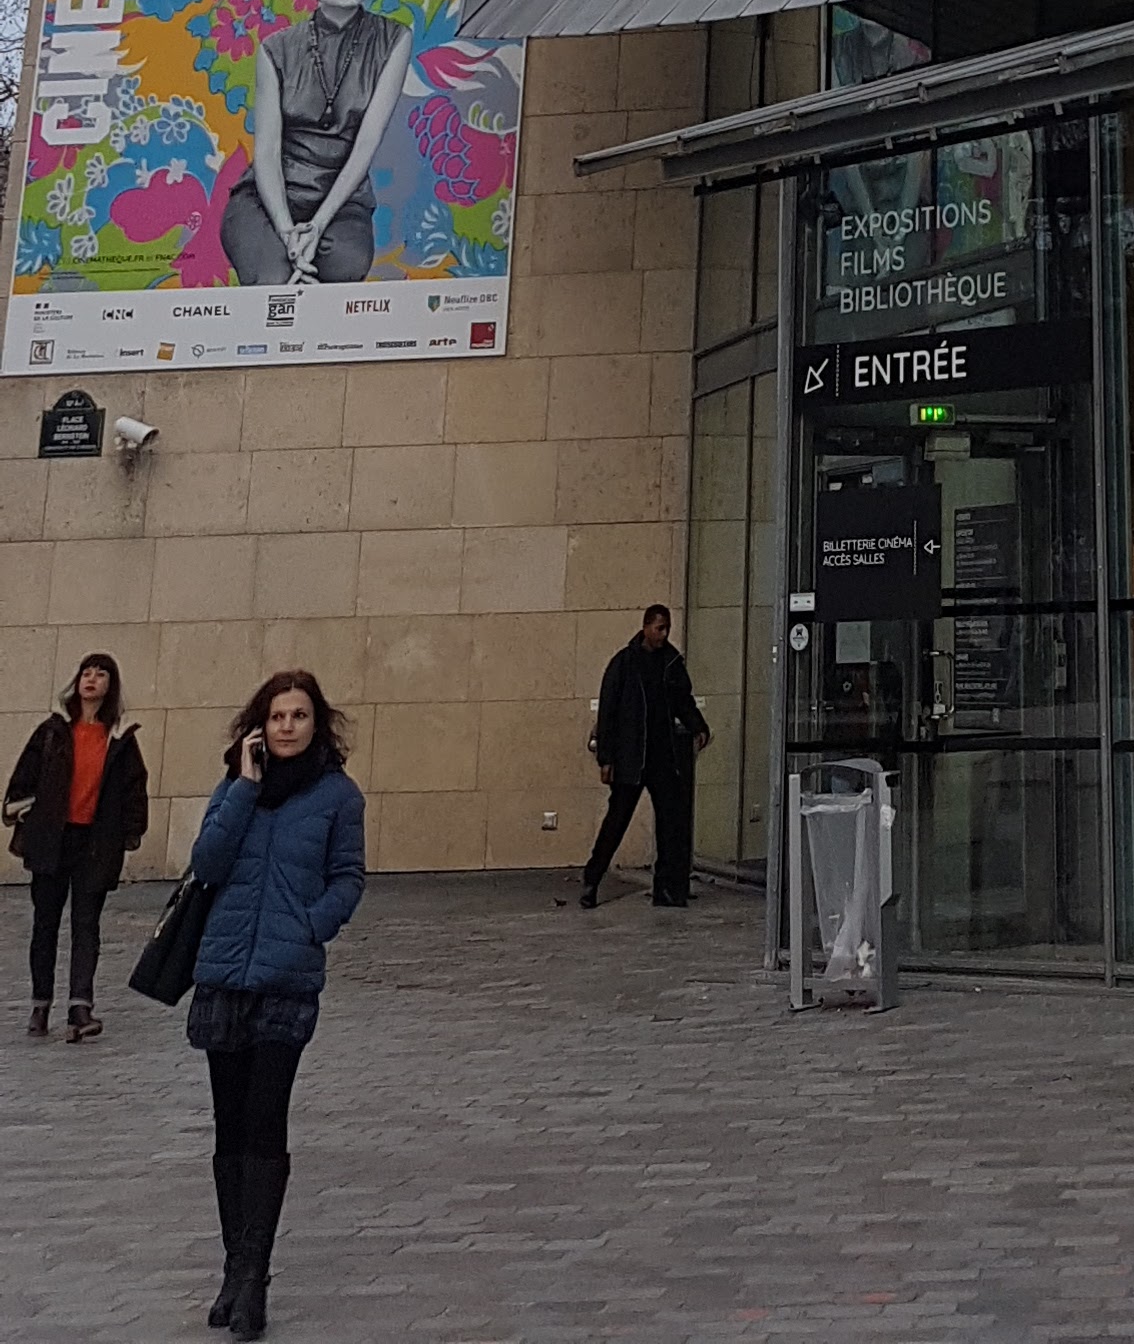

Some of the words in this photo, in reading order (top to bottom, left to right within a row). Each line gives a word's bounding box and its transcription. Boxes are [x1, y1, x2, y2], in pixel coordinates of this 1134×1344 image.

[840, 199, 992, 241] EXPOSITIONS
[840, 246, 905, 277] FILMS
[839, 272, 1007, 314] BIBLIOTHÈQUE
[172, 305, 231, 318] CHANEL
[268, 303, 295, 318] gan
[345, 298, 391, 314] NETFLIX
[428, 337, 457, 347] arte
[853, 340, 968, 388] ENTRÉE
[823, 538, 876, 552] BILLETTERIE
[877, 535, 913, 550] CINÉMA
[822, 552, 852, 566] ACCÈS
[853, 552, 886, 566] SALLES
